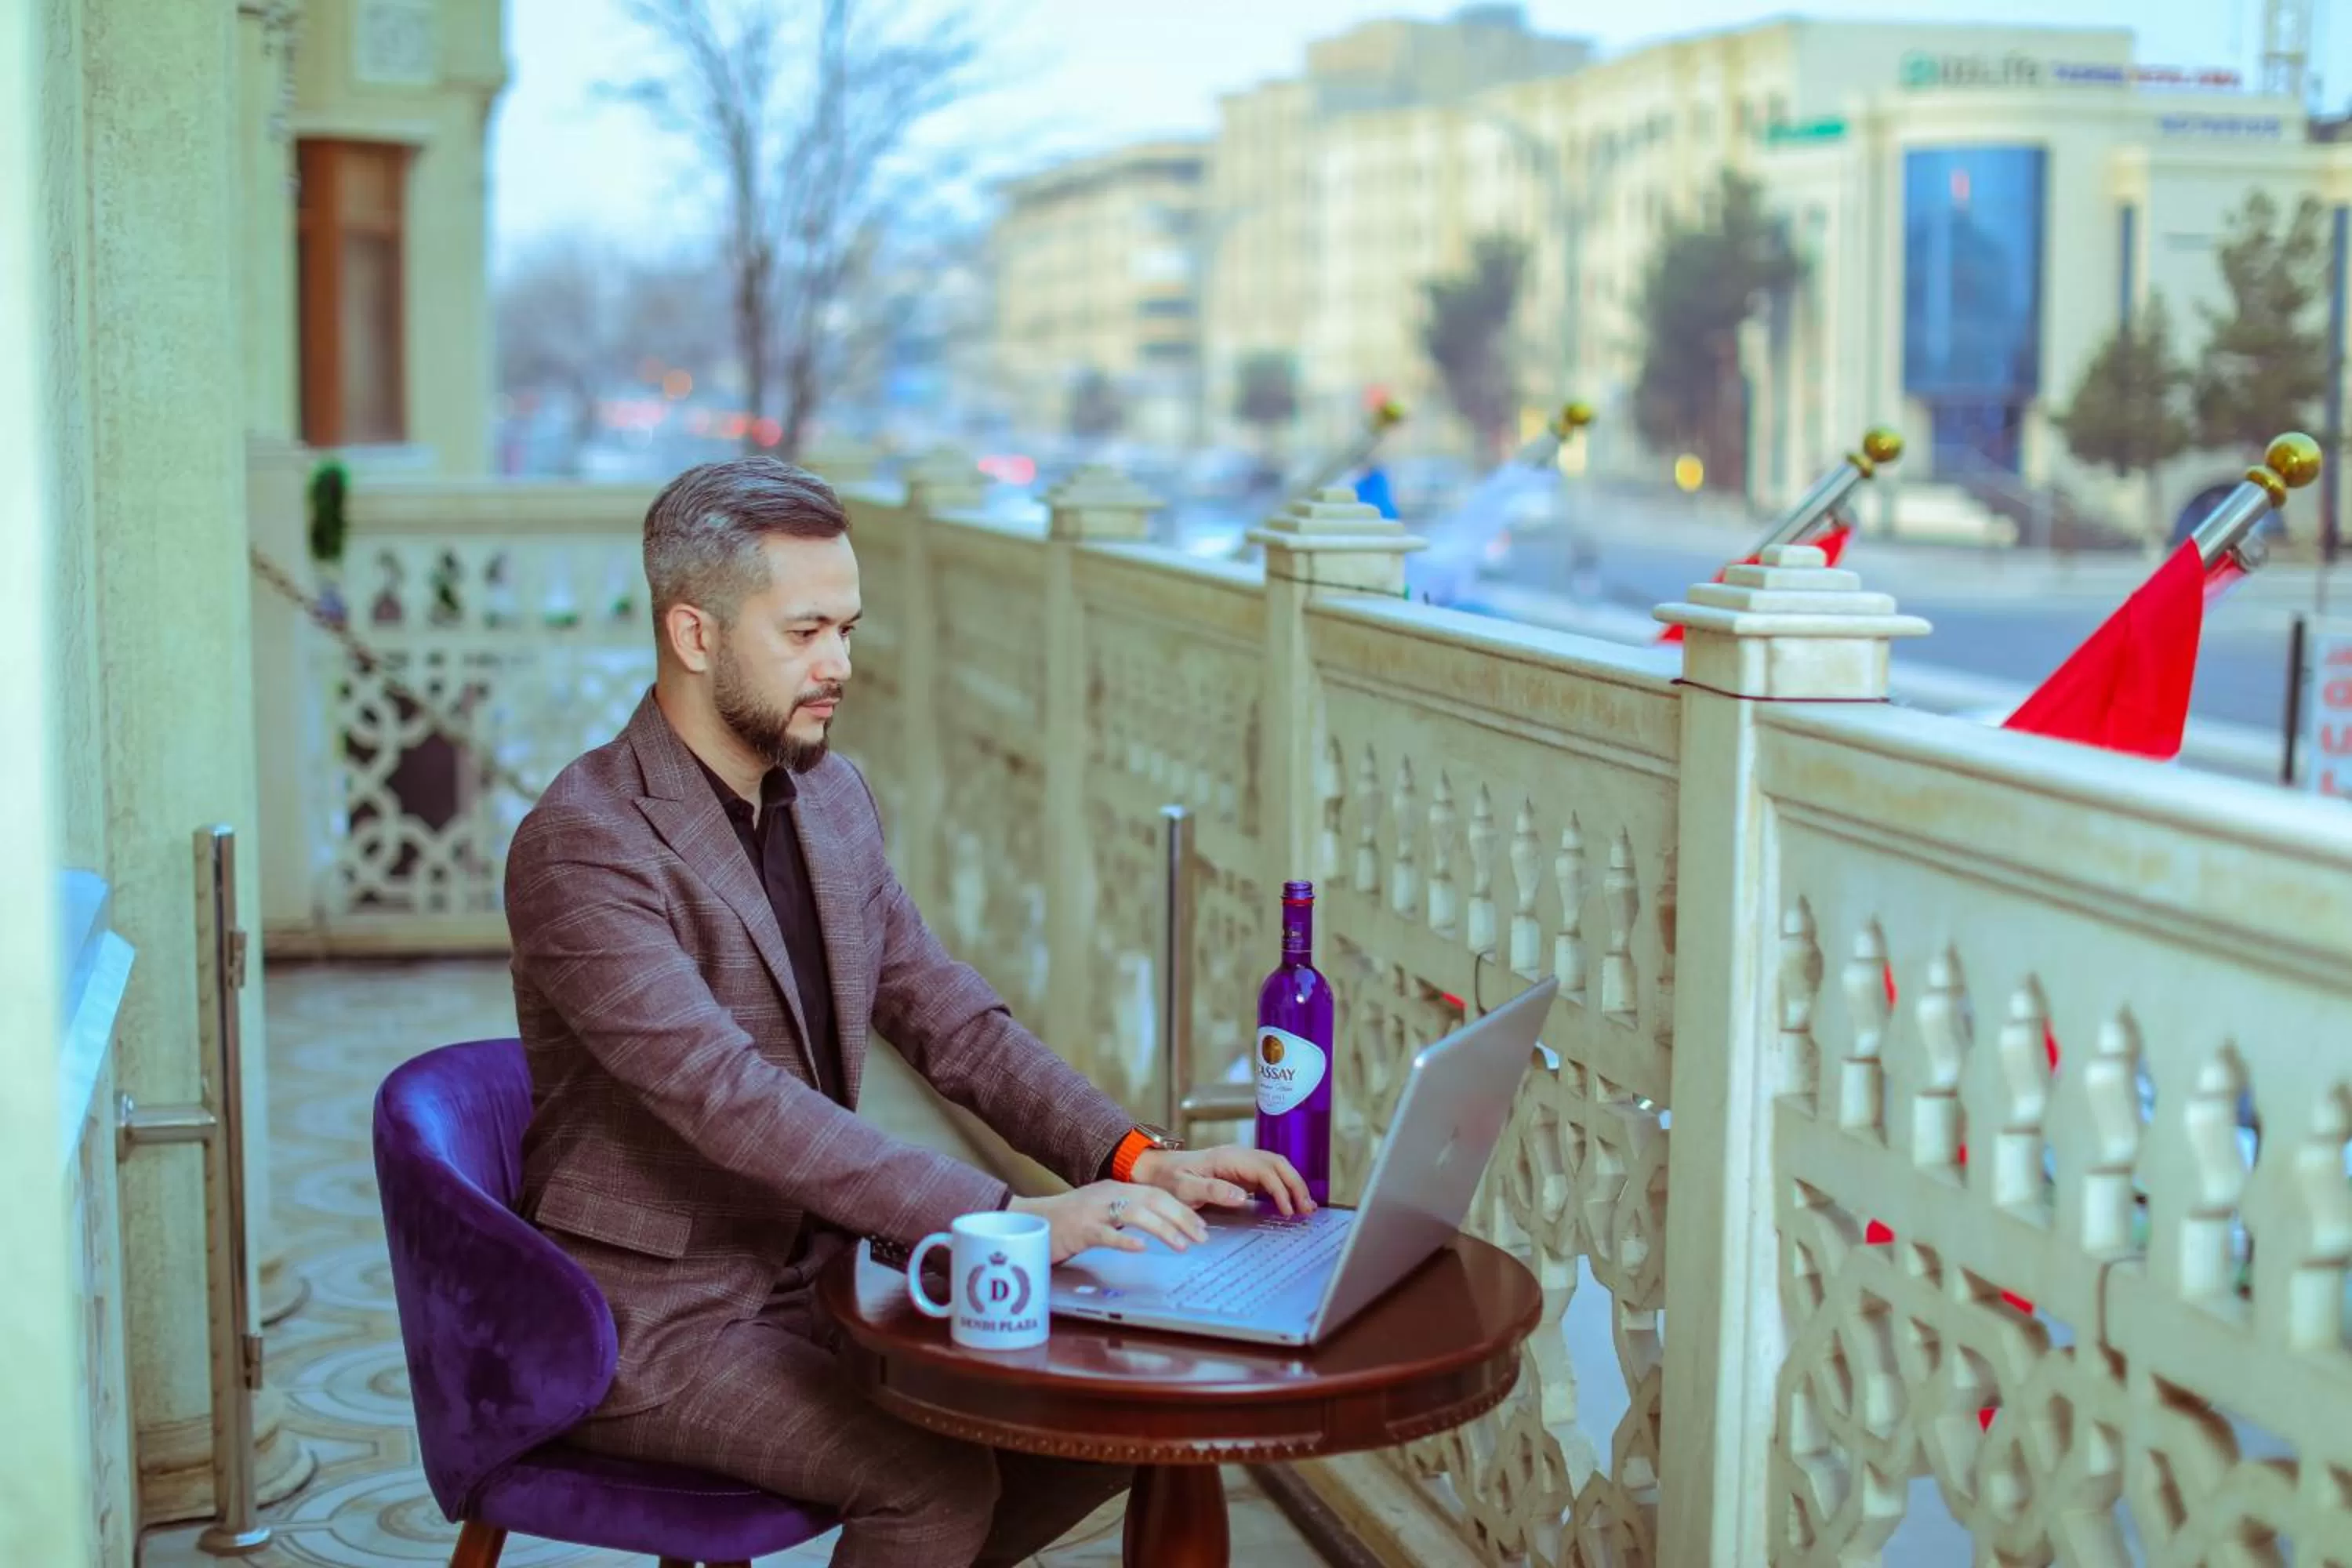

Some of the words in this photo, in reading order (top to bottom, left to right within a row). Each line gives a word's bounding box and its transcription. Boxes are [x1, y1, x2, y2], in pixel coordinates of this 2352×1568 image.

[1258, 1064, 1295, 1080] ASSAY
[990, 1279, 1010, 1301] D
[1000, 1318, 1038, 1332] PLAZA
